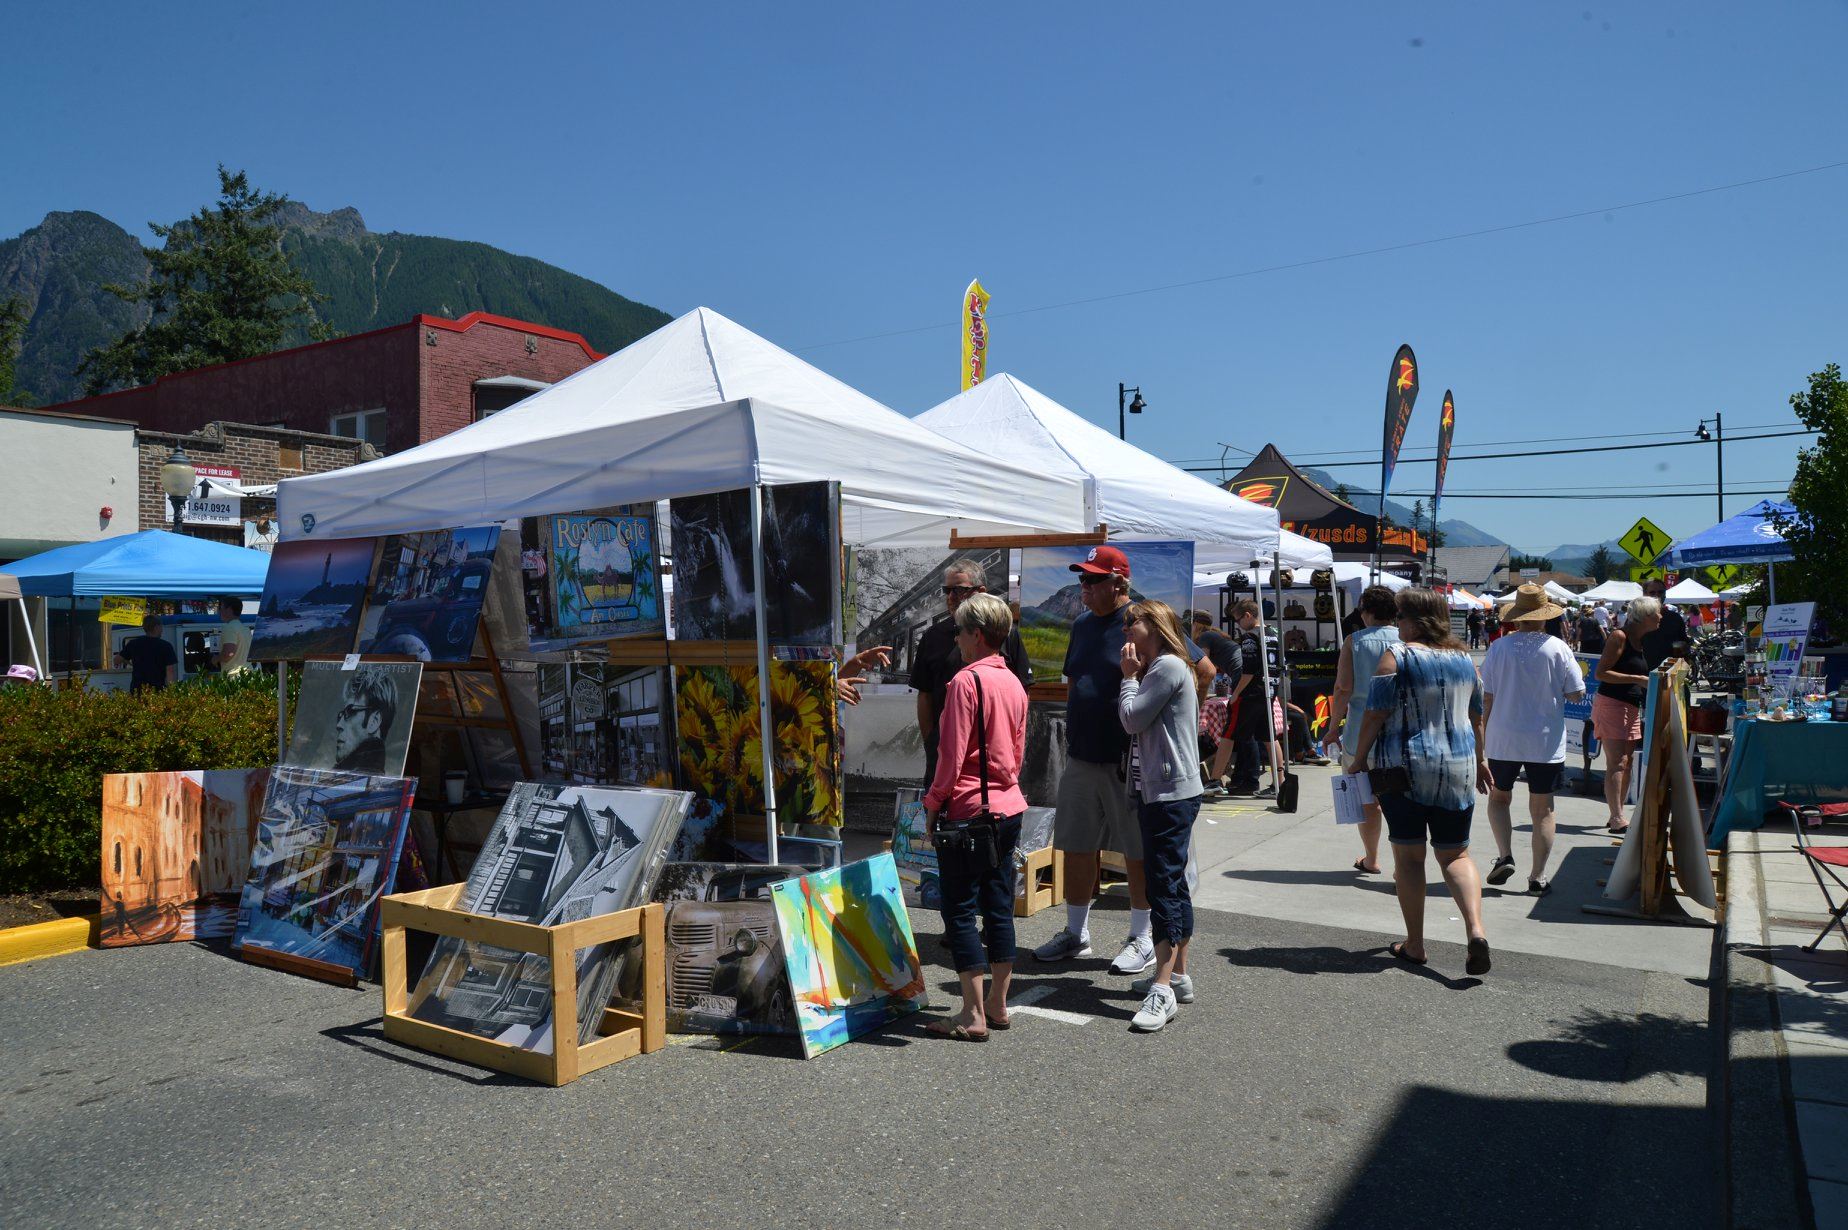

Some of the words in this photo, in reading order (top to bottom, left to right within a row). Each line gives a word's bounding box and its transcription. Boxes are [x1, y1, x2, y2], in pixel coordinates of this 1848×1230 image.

[218, 469, 233, 477] LEASE
[557, 518, 612, 548] Roslyn
[616, 519, 646, 547] Cafe
